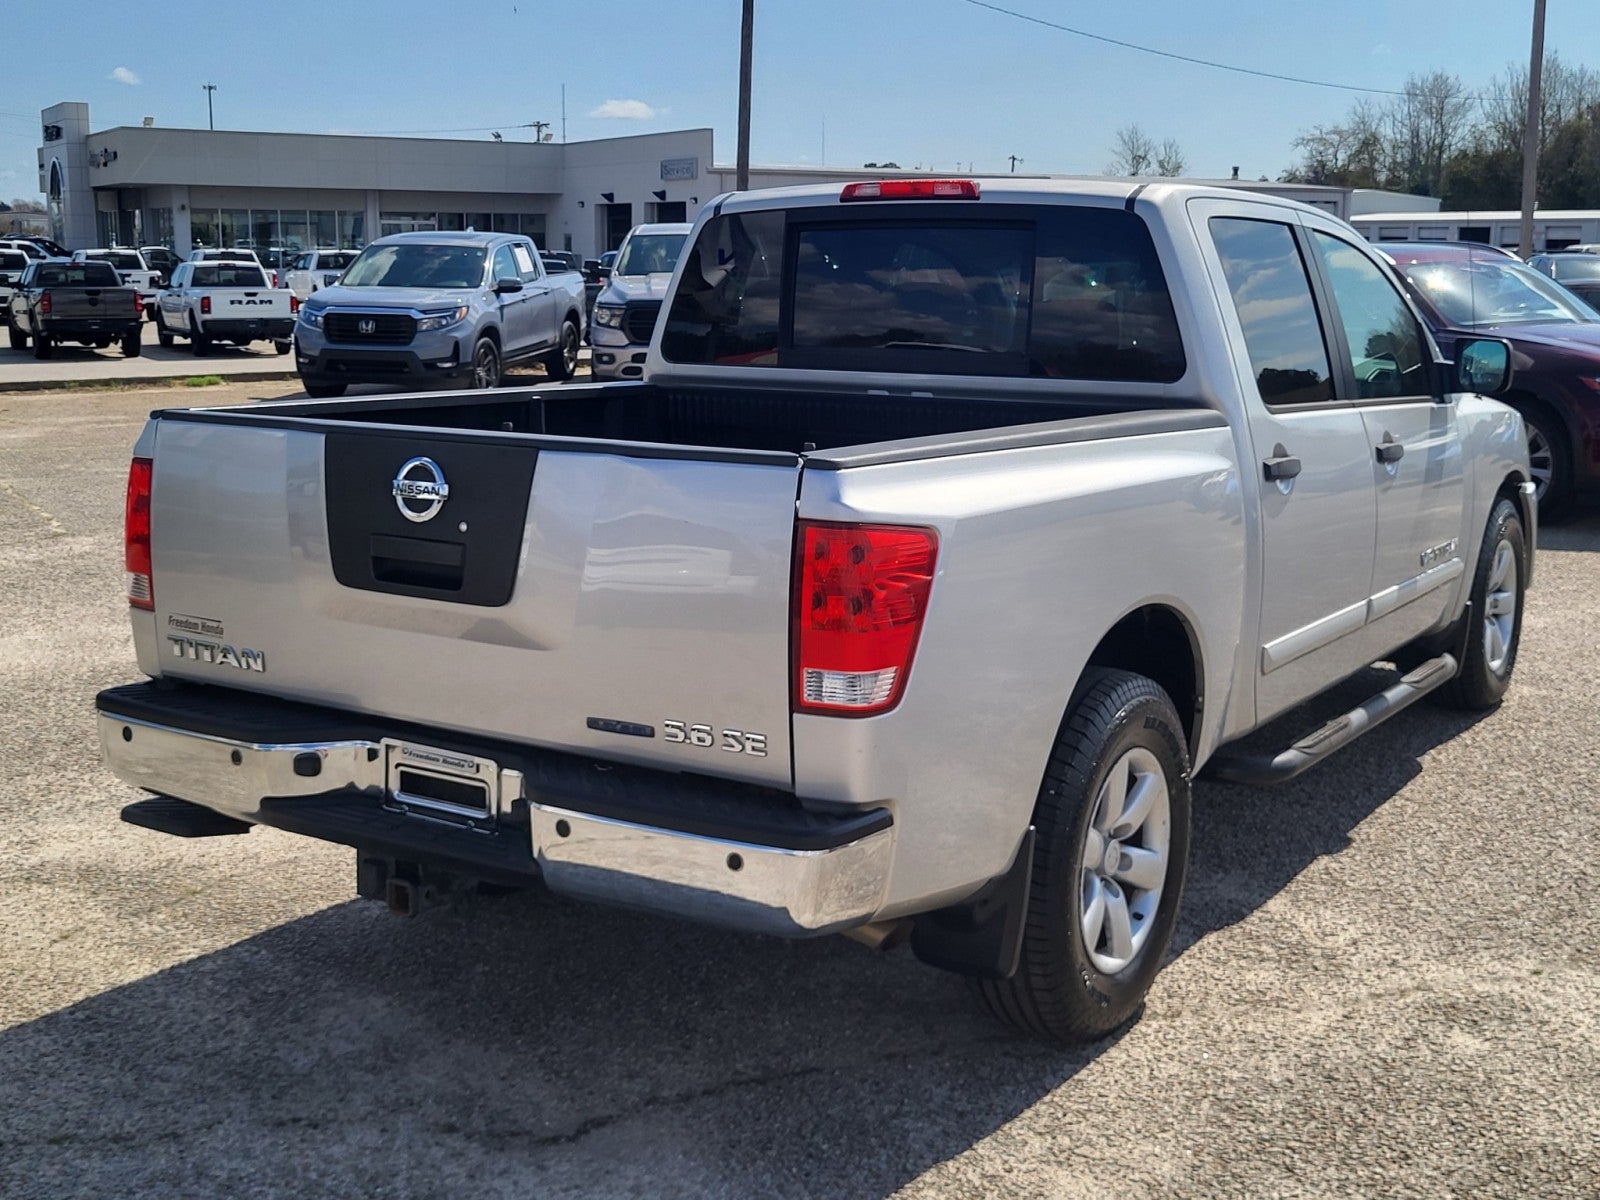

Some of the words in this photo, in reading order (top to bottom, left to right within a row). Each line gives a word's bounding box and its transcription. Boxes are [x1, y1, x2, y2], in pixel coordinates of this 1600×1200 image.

[396, 482, 440, 496] NISSAN
[168, 615, 200, 631] Freedom
[200, 621, 224, 636] Honda
[167, 635, 266, 672] TITAN
[664, 720, 714, 747] 5.6
[721, 729, 767, 757] SE
[408, 750, 441, 763] Freedom
[441, 757, 466, 769] Honda
